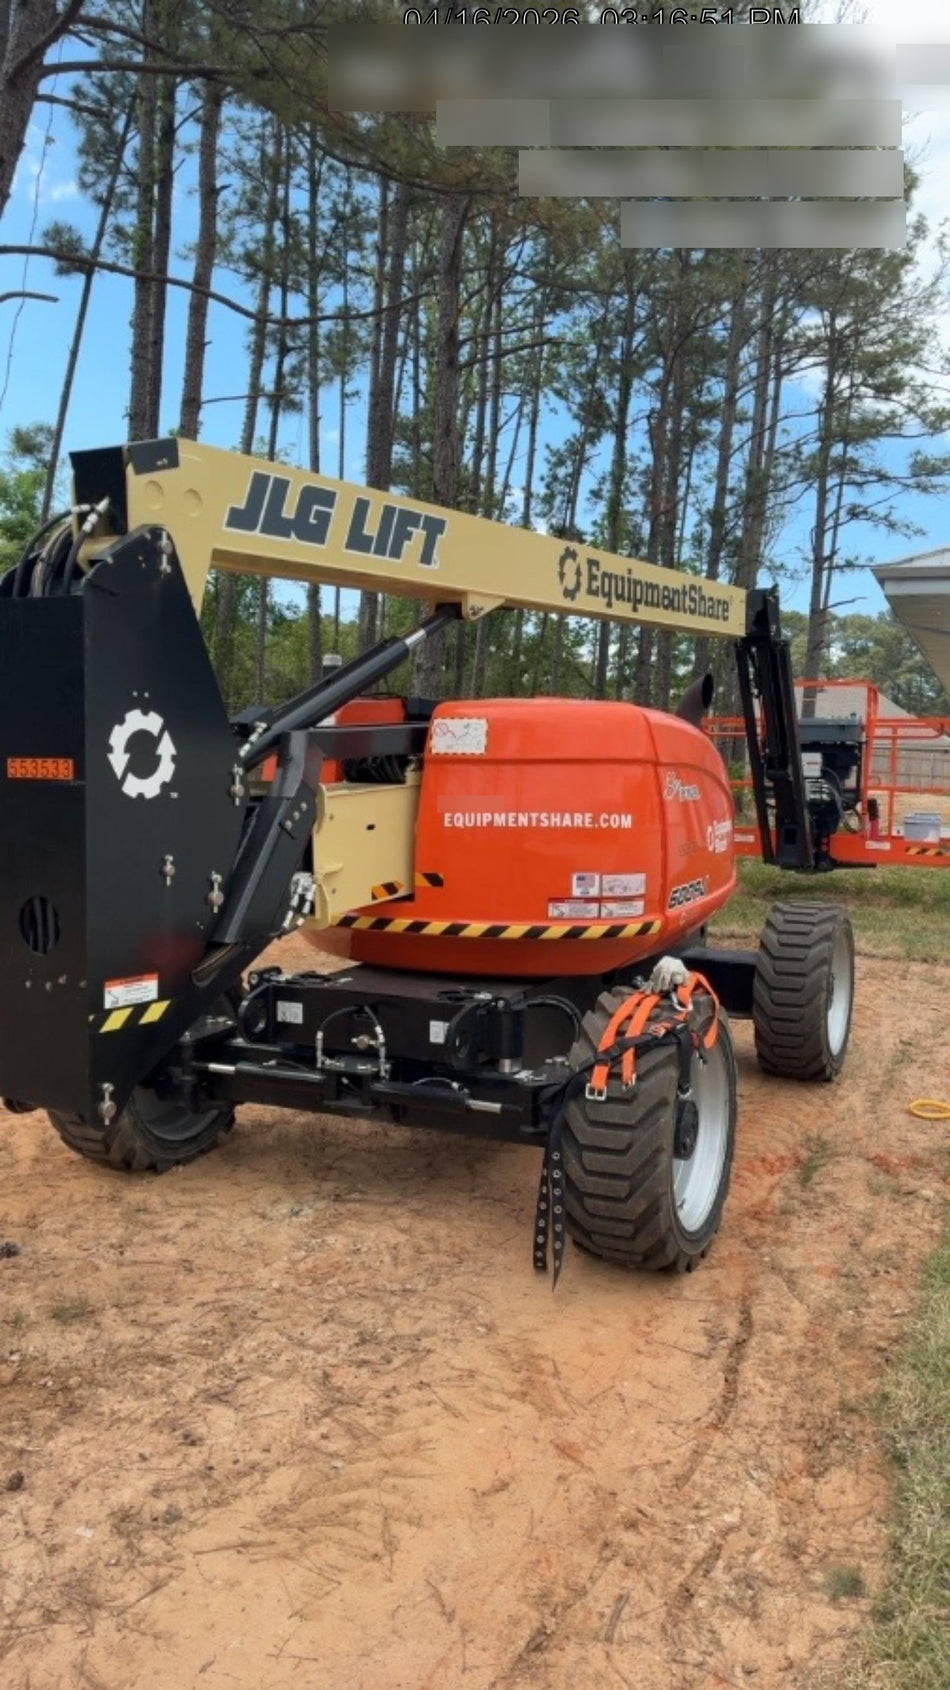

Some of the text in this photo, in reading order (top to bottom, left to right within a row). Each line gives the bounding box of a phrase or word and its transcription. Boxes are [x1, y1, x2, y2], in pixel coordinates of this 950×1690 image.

[224, 471, 447, 569] JLG LIFT
[586, 557, 729, 622] EquipmentShare
[9, 759, 71, 778] 553533
[444, 812, 632, 829] EQUIPMENTSHARE.COM
